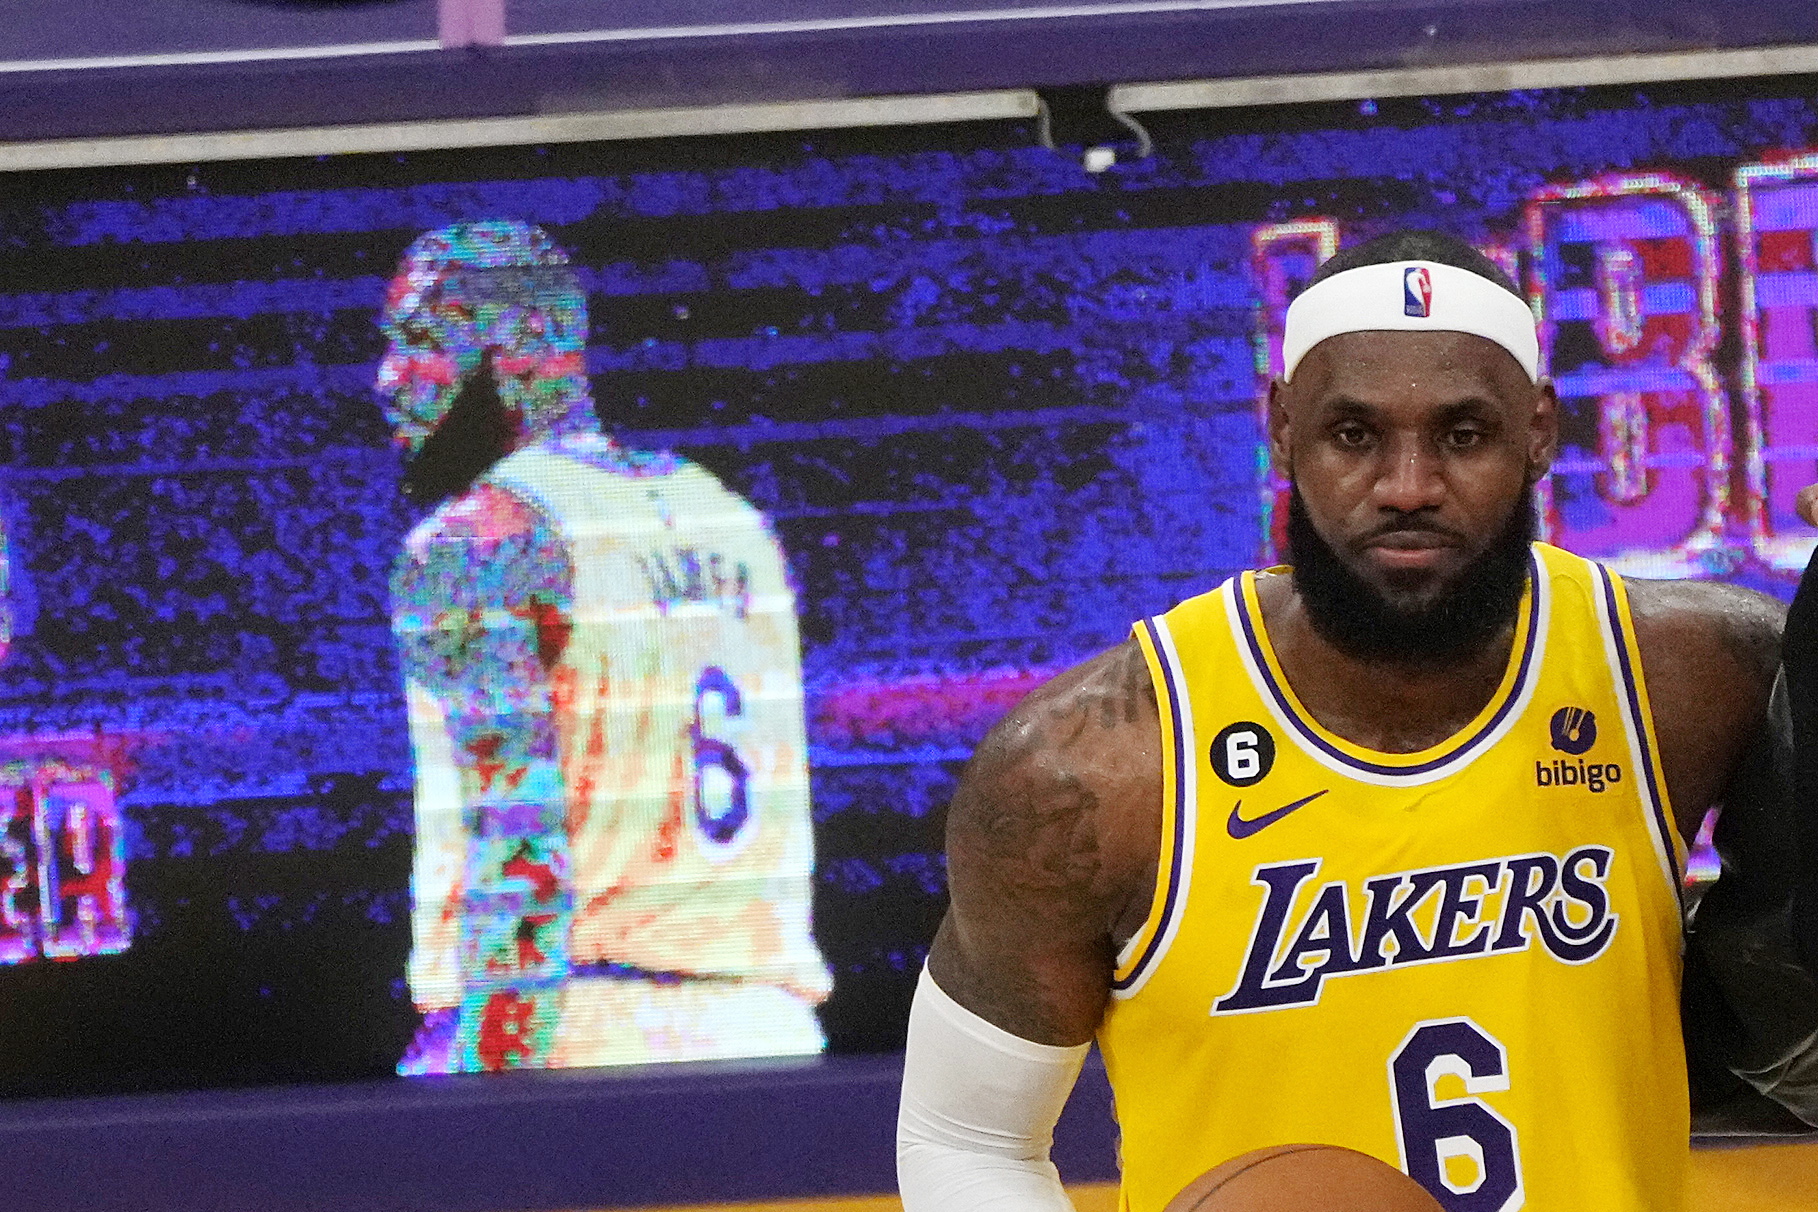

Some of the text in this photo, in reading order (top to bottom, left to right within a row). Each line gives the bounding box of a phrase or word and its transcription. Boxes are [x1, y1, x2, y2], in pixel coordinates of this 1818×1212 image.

[688, 664, 752, 848] 6
[1225, 731, 1262, 779] 6
[1535, 759, 1622, 792] bibigo
[1209, 843, 1621, 1017] LAKERS
